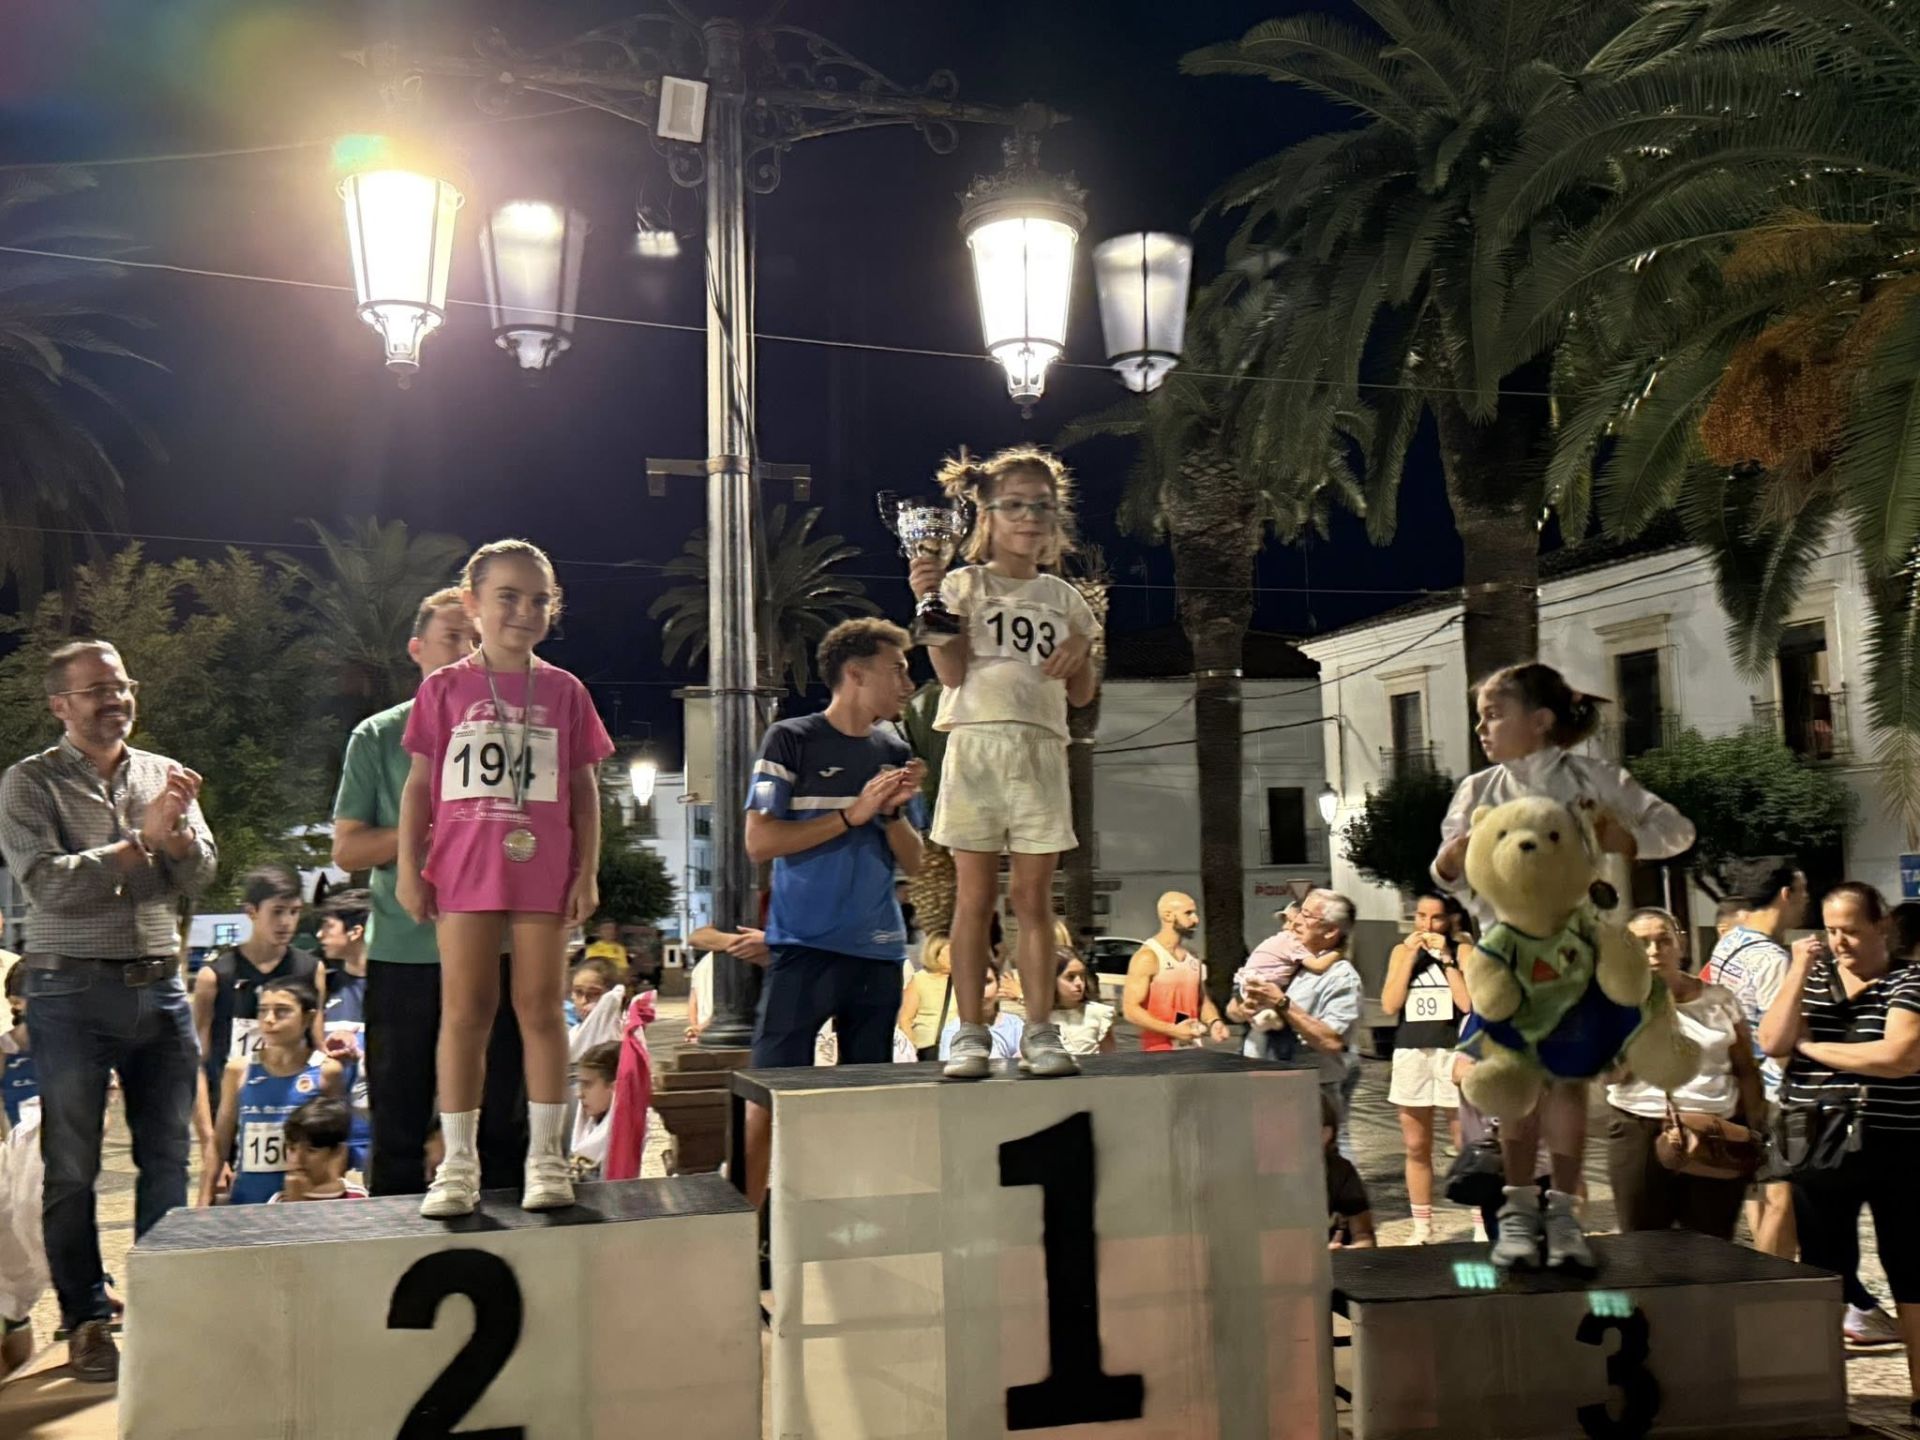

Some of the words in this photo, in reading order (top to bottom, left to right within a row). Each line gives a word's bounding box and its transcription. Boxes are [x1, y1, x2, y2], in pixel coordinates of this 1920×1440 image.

[986, 611, 1056, 659] 193
[453, 742, 536, 790] 194
[1415, 997, 1438, 1016] 89
[249, 1136, 287, 1165] 15
[998, 1111, 1144, 1431] 1
[385, 1248, 526, 1440] 2
[1575, 1304, 1660, 1440] 3
